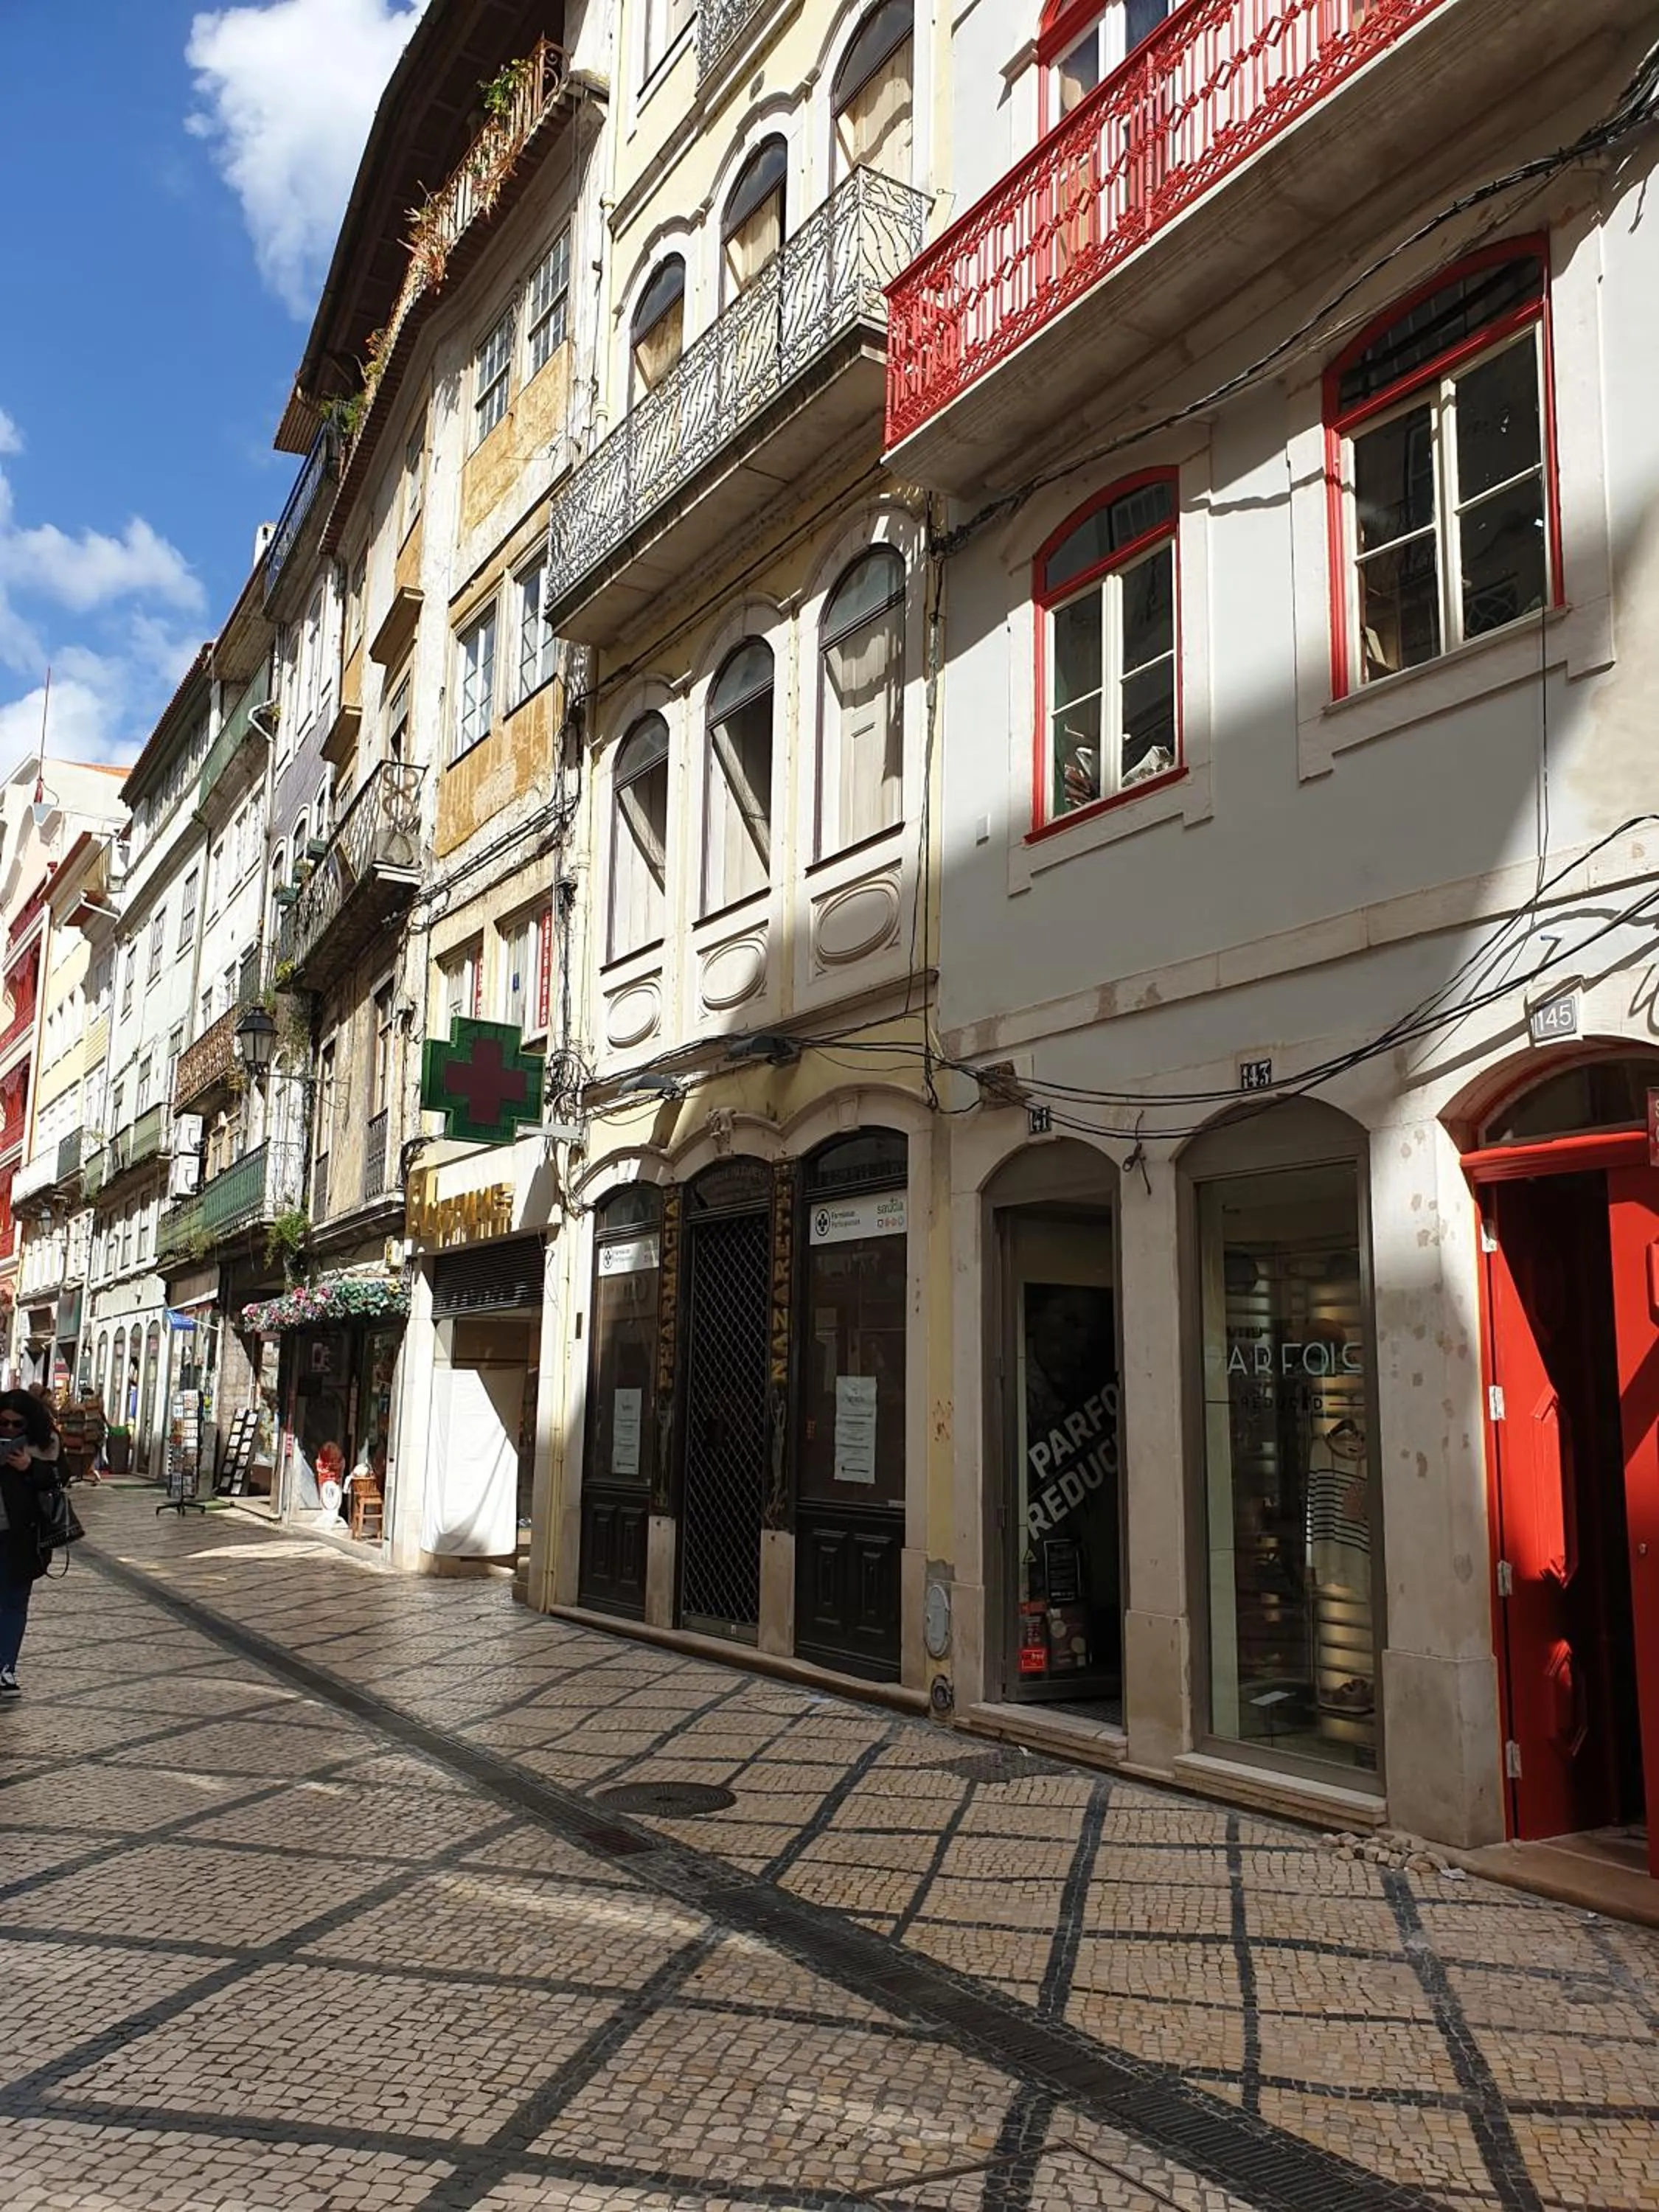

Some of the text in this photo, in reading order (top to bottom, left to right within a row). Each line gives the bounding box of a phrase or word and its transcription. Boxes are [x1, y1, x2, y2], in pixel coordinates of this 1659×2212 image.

[1537, 1004, 1571, 1032] 145
[1242, 1062, 1270, 1089] 143
[1029, 1108, 1047, 1132] 141
[660, 1199, 679, 1390] PHARMACIA
[771, 1183, 792, 1382] NAZARETH
[1028, 1433, 1118, 1542] REDUC
